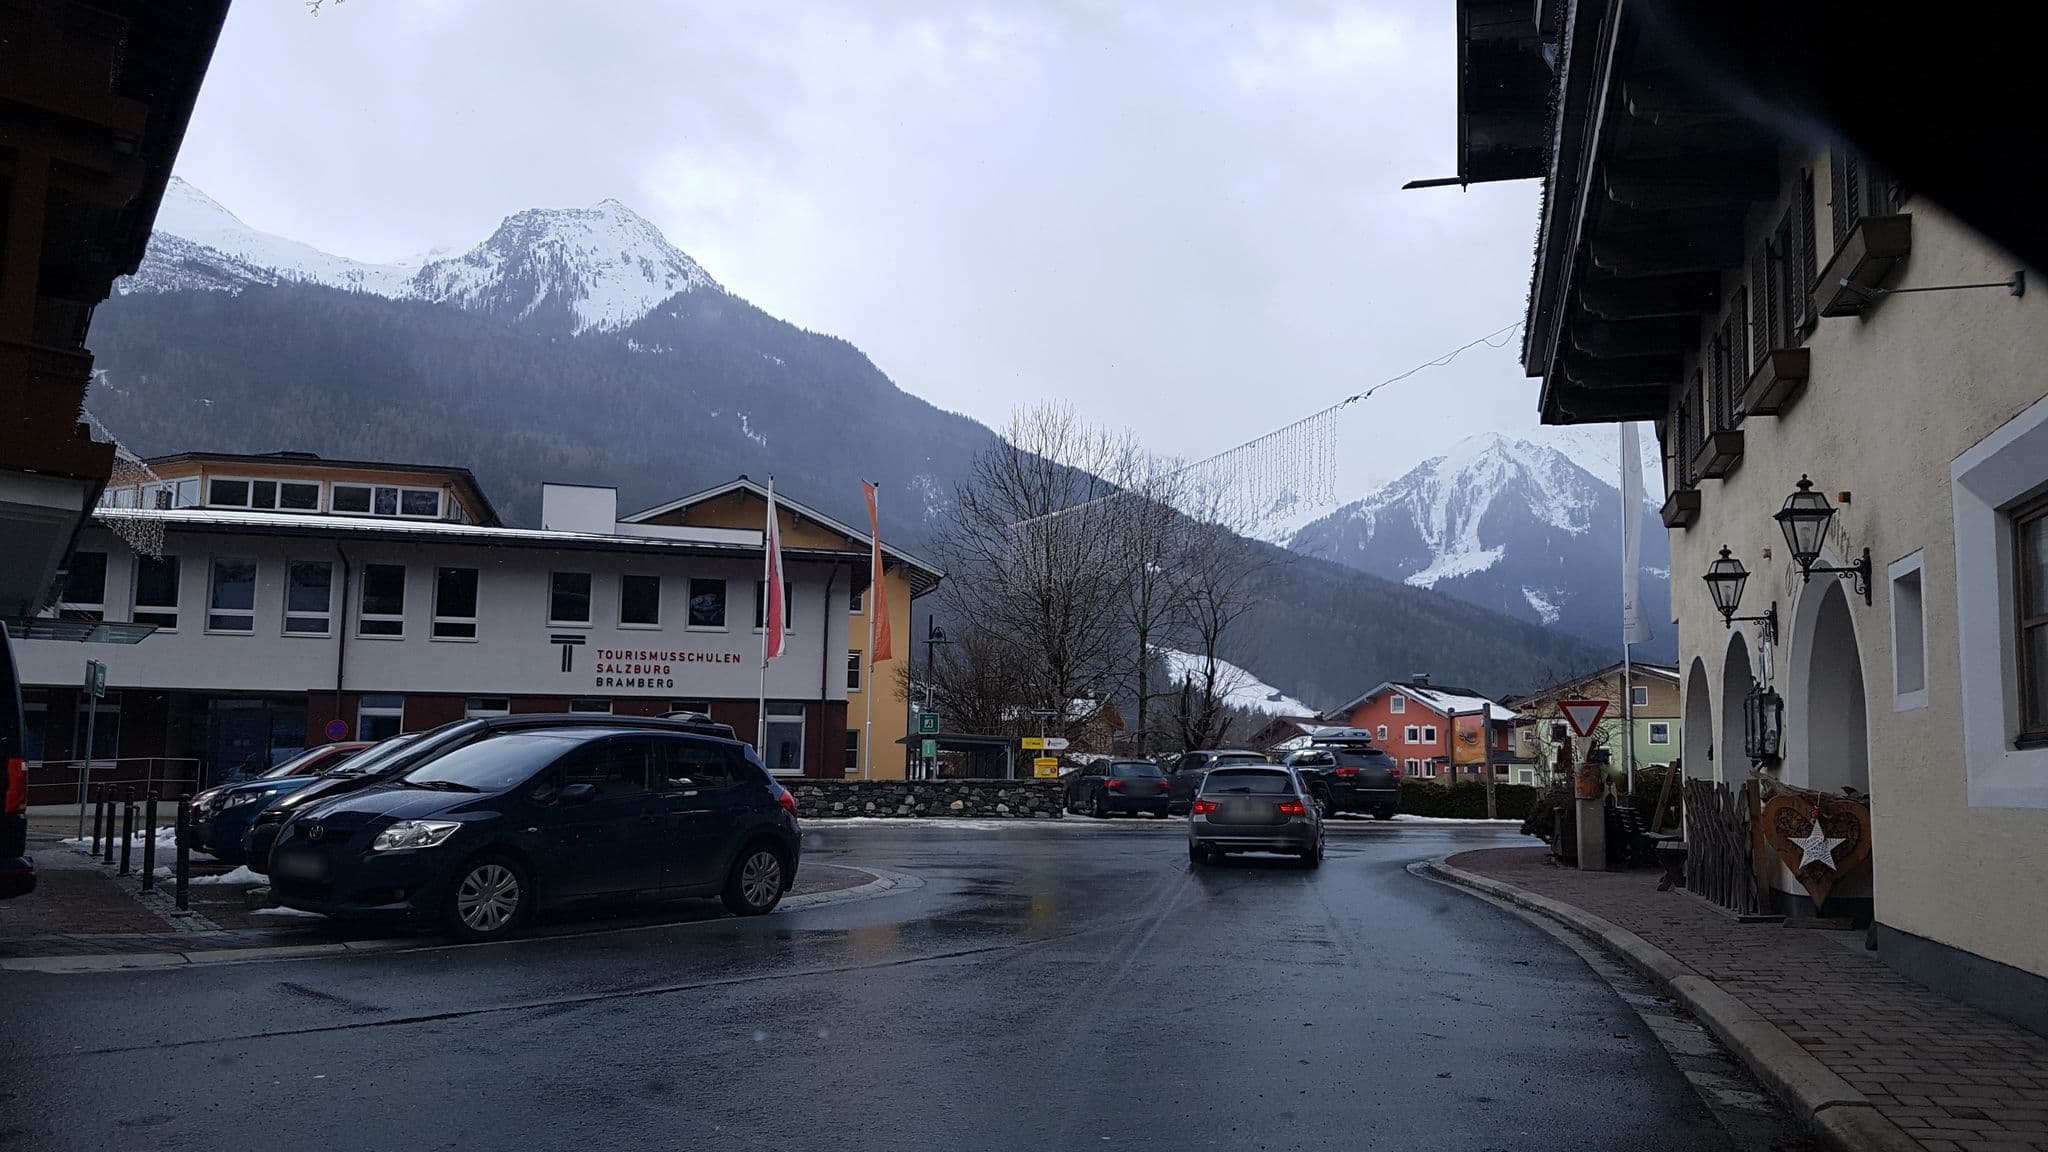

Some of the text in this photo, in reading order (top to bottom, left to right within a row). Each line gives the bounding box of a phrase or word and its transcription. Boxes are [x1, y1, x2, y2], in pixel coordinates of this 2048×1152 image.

[597, 649, 741, 664] TOURISMUSSCHULEN
[596, 663, 671, 675] SALZBURG
[595, 677, 674, 689] BRAMBERG
